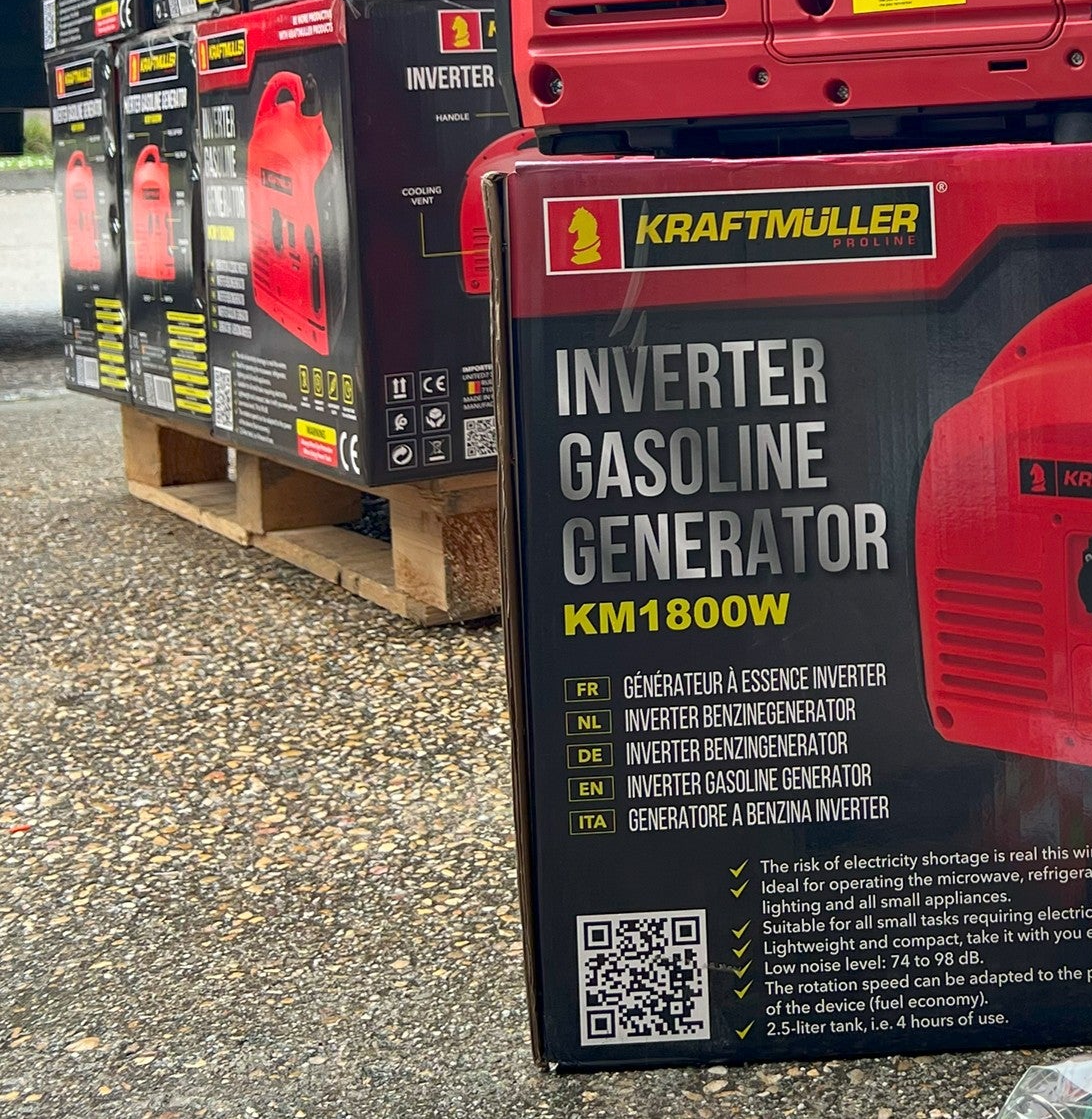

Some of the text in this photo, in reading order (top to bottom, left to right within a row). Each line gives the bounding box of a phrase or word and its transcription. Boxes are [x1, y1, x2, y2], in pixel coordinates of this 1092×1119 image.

[406, 65, 495, 91] INVERTER
[435, 112, 470, 122] HANDLE
[402, 186, 442, 198] COOLING
[411, 196, 435, 206] VENT
[635, 204, 918, 245] KRAFTMÜLLER
[833, 235, 916, 248] PROLINE
[556, 338, 827, 416] INVERTER
[559, 421, 828, 500] GASOLINE
[562, 503, 889, 584] GENERATOR
[564, 593, 790, 635] KM1800W
[577, 681, 599, 696] FR
[624, 663, 886, 699] GÉNÉRATEUR À ESSENCE INVERTER
[577, 715, 601, 730] NL
[625, 698, 855, 732] INVERTER BENZINEGENERATOR
[578, 748, 602, 763] DE
[627, 732, 848, 765] INVERTER BENZINGENERATOR
[579, 782, 603, 796] EN
[628, 764, 871, 798] INVERTER GASOLINE GENERATOR
[579, 814, 607, 830] ITA
[629, 796, 889, 831] GENERATORE A BENZINA INVERTER
[760, 859, 788, 873] The
[794, 857, 820, 872] risk
[825, 856, 840, 870] of
[844, 854, 917, 870] electricity
[922, 851, 989, 867] shortage
[994, 849, 1005, 862] is
[1010, 847, 1037, 861] real
[1042, 846, 1068, 860] this
[762, 878, 798, 894] Ideal
[803, 878, 825, 891] for
[830, 875, 903, 894] operating
[908, 872, 932, 886] the
[938, 871, 1023, 885] microwave,
[763, 891, 1011, 917] lighting and all small appliances.
[763, 918, 825, 934] Suitable
[829, 917, 851, 930] for
[856, 915, 872, 929] all
[878, 913, 916, 928] small
[921, 911, 959, 926] tasks
[964, 909, 1032, 927] requiring
[764, 937, 855, 957] Lightweight
[859, 935, 887, 949] and
[893, 933, 962, 950] compact,
[967, 930, 999, 944] take
[1004, 929, 1013, 942] it
[1018, 927, 1049, 941] with
[1054, 930, 1081, 944] you
[765, 951, 983, 974] Low noise level: 74 to 98 dB.
[765, 981, 793, 995] The
[799, 979, 857, 993] rotation
[863, 974, 909, 993] speed
[914, 977, 940, 987] can
[946, 972, 965, 985] be
[970, 968, 1033, 987] adapted
[1038, 970, 1053, 981] to
[1058, 966, 1082, 980] the
[766, 991, 988, 1015] of the device (fuel economy).
[767, 1011, 1008, 1035] 2.5-liter tank, i.e. 4 hours of use.
